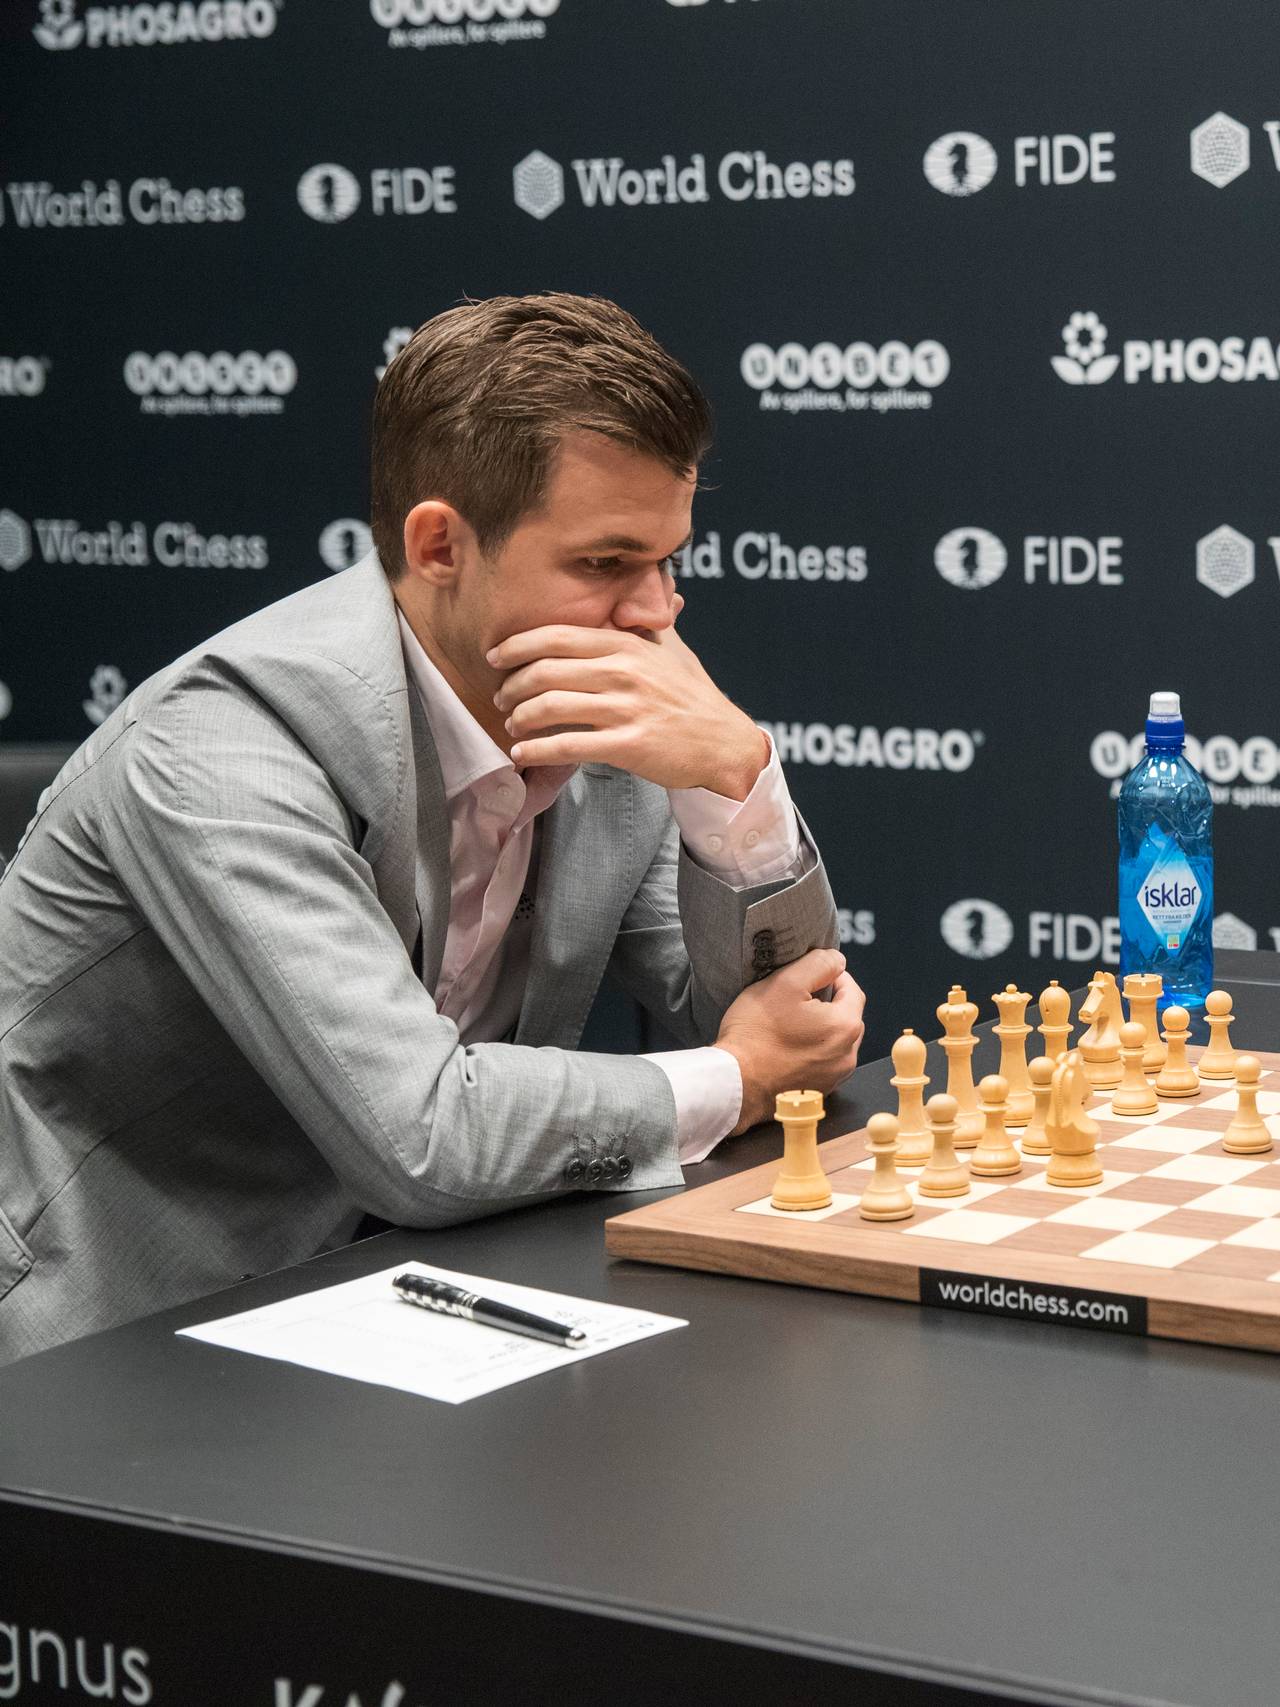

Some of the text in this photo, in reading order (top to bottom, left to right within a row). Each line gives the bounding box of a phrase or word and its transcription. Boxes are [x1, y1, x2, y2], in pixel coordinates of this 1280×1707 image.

[85, 0, 277, 47] PHOSAGRO
[572, 150, 856, 207] World Chess
[1014, 131, 1116, 187] FIDE
[7, 177, 246, 228] World Chess
[370, 165, 457, 215] FIDE
[34, 519, 268, 569] World Chess
[732, 531, 868, 582] Chess
[1023, 536, 1124, 586] FIDE
[1144, 882, 1197, 908] isklar
[1029, 911, 1121, 964] FIDE
[938, 1281, 1129, 1325] worldchess.com
